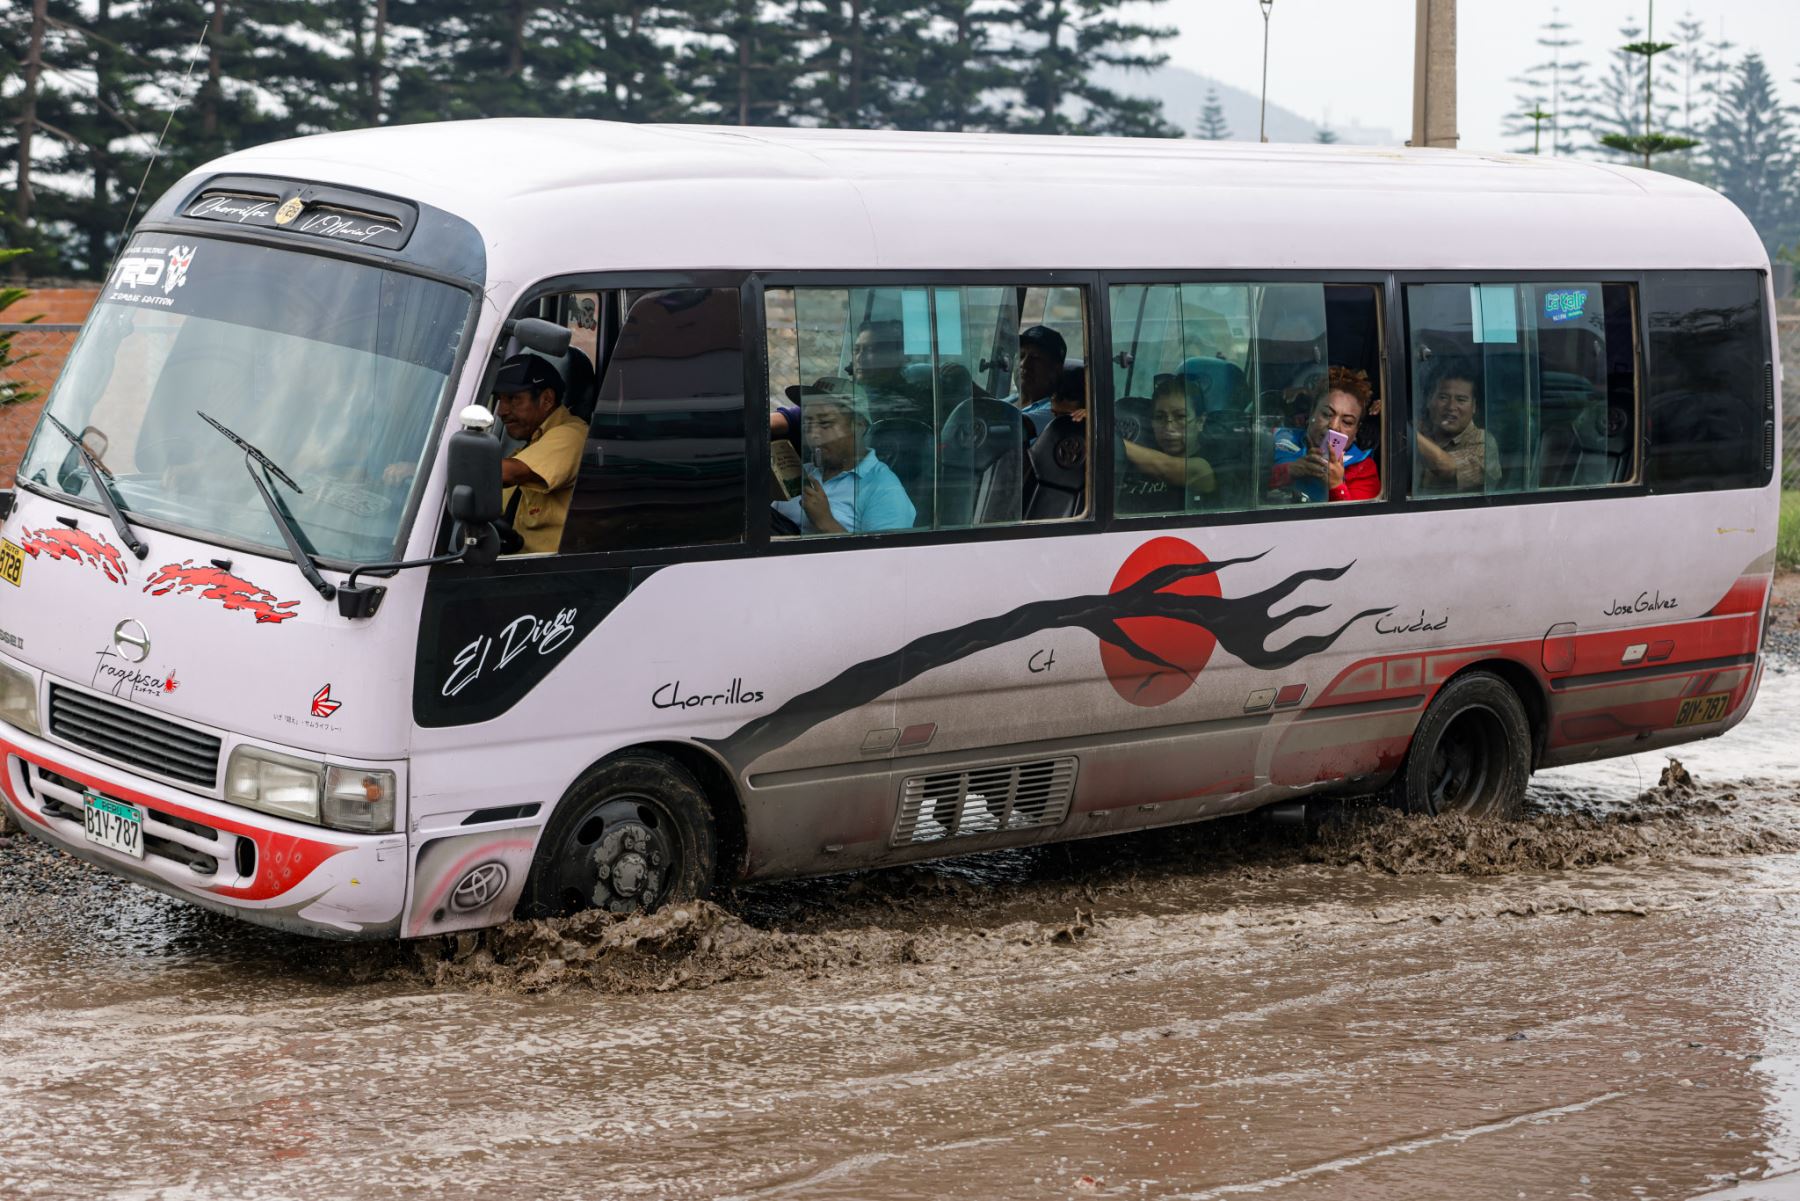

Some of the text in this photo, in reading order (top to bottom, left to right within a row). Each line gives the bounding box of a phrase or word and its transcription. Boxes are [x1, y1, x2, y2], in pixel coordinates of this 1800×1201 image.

[1375, 609, 1448, 635] Ciudad
[442, 607, 577, 696] El Diego
[651, 677, 765, 710] Chorrillos
[102, 800, 122, 816] PERU
[86, 806, 139, 849] B1Y-787
